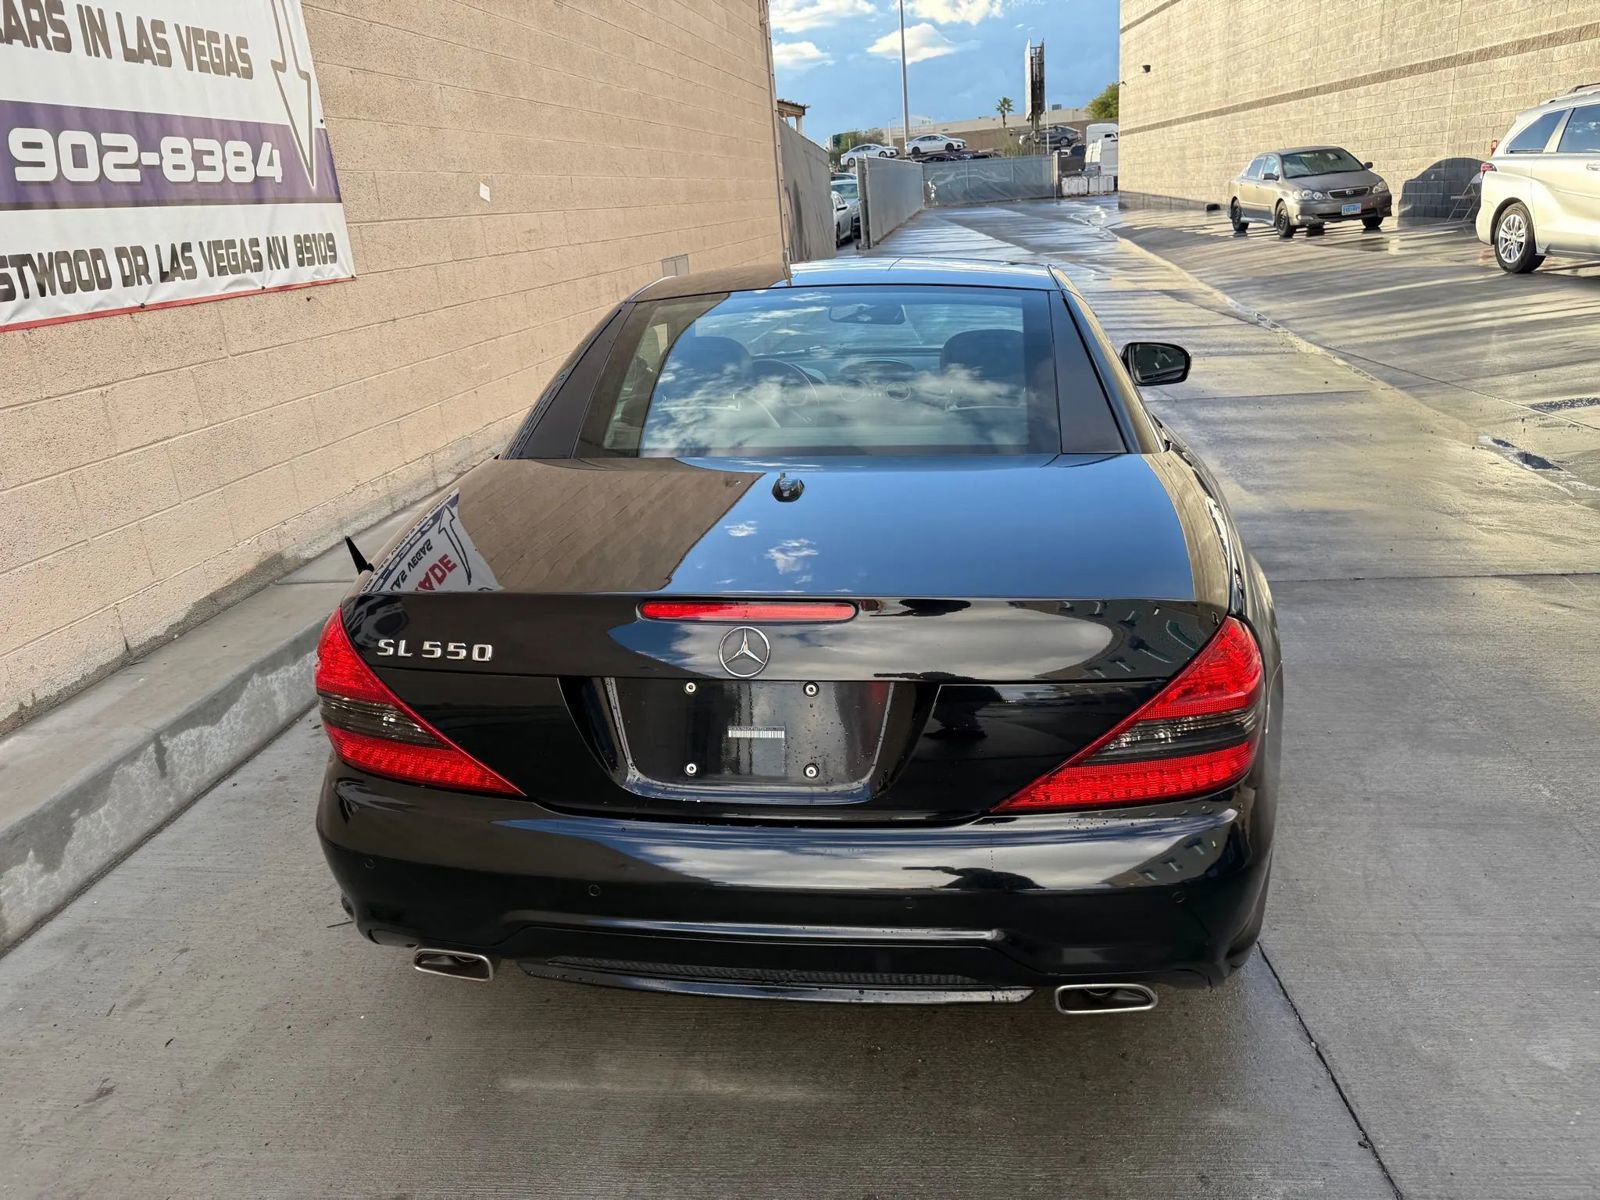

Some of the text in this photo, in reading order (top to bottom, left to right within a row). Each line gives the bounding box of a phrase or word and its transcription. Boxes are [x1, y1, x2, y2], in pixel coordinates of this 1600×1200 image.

[0, 0, 254, 80] ARS IN LAS VEGAS
[8, 127, 283, 183] 902-8384
[114, 245, 153, 288] DR
[155, 241, 198, 283] LAS
[198, 237, 261, 277] VEGAS
[266, 235, 290, 270] NV
[293, 232, 338, 267] 89109
[376, 638, 493, 662] SL 550
